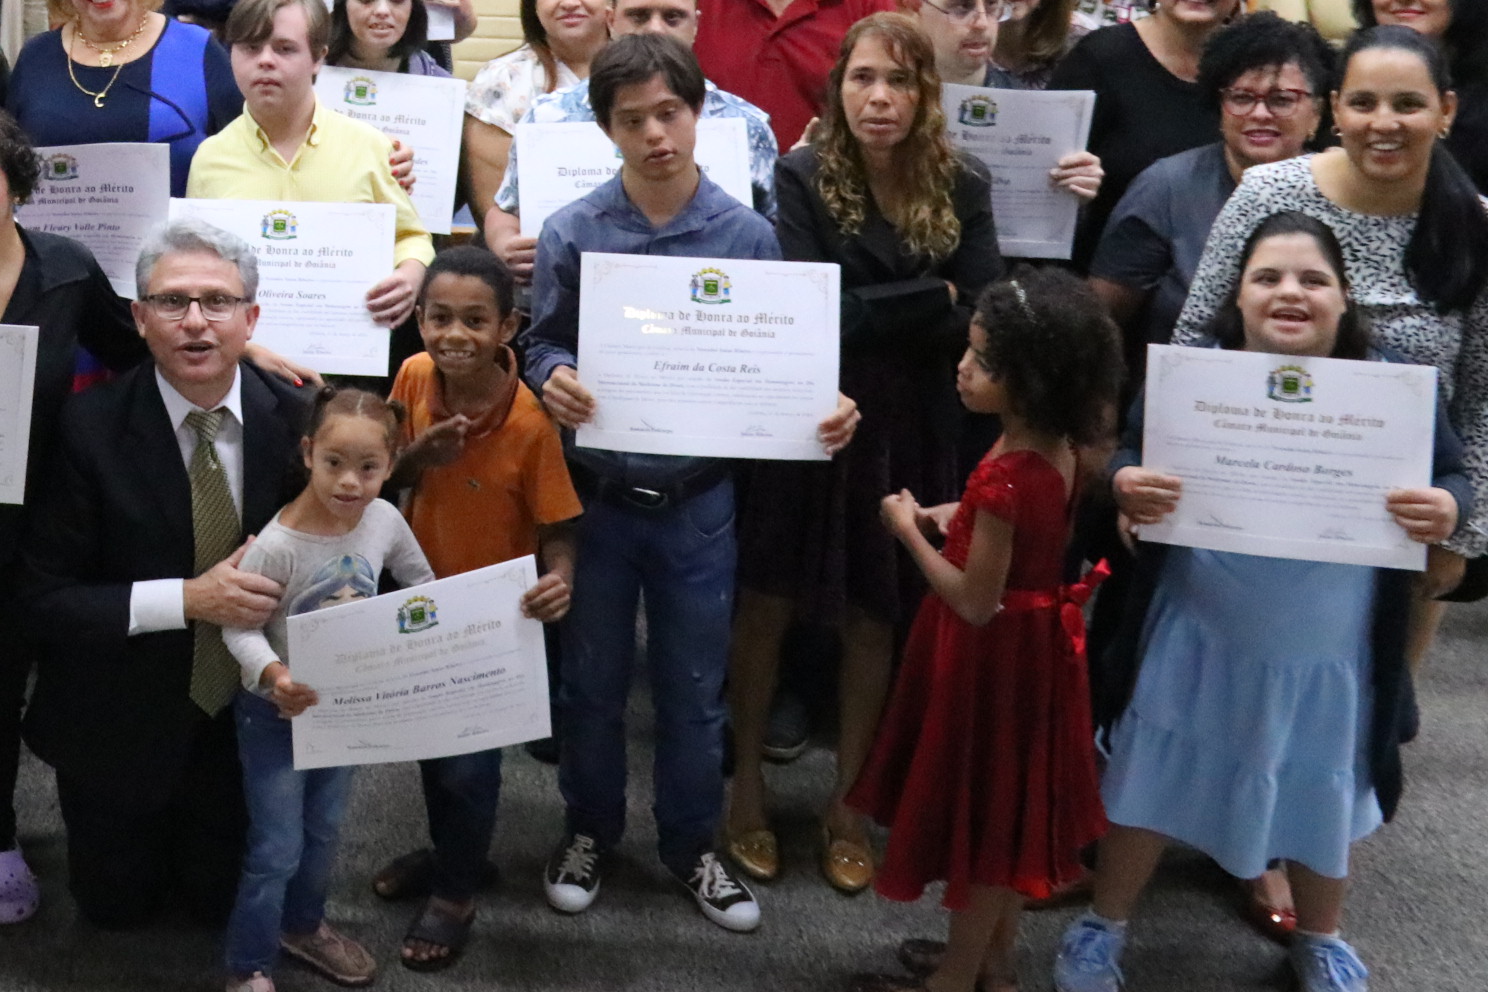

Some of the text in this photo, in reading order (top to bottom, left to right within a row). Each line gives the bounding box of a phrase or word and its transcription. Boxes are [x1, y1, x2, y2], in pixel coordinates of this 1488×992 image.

[347, 109, 377, 120] Honra
[394, 114, 426, 126] Mérito
[557, 167, 616, 177] Diploma de
[50, 185, 81, 194] Honra
[99, 183, 134, 193] Mérito
[37, 196, 75, 205] Municipal
[98, 223, 120, 231] Pinto
[266, 245, 298, 256] Honra
[302, 248, 314, 256] ao
[317, 246, 353, 257] Mérito
[294, 260, 302, 268] de
[304, 260, 336, 268] Goiânia
[258, 289, 326, 300] Oliveira Soares
[678, 311, 691, 321] de
[695, 310, 733, 323] Honra
[736, 315, 750, 324] ao
[753, 312, 795, 326] Mérito
[681, 325, 725, 337] Municipal
[729, 327, 737, 337] de
[740, 329, 776, 338] Goiânia
[653, 360, 761, 373] Efraim da Costa Reis
[1194, 400, 1385, 428] Diploma de Honra ao Mérito
[1216, 455, 1353, 478] Marcela Cardoso Borges
[389, 643, 401, 654] de
[446, 632, 458, 641] ao
[462, 619, 501, 638] Mérito
[333, 666, 506, 705] Melissa Vitória Barros Nascimento
